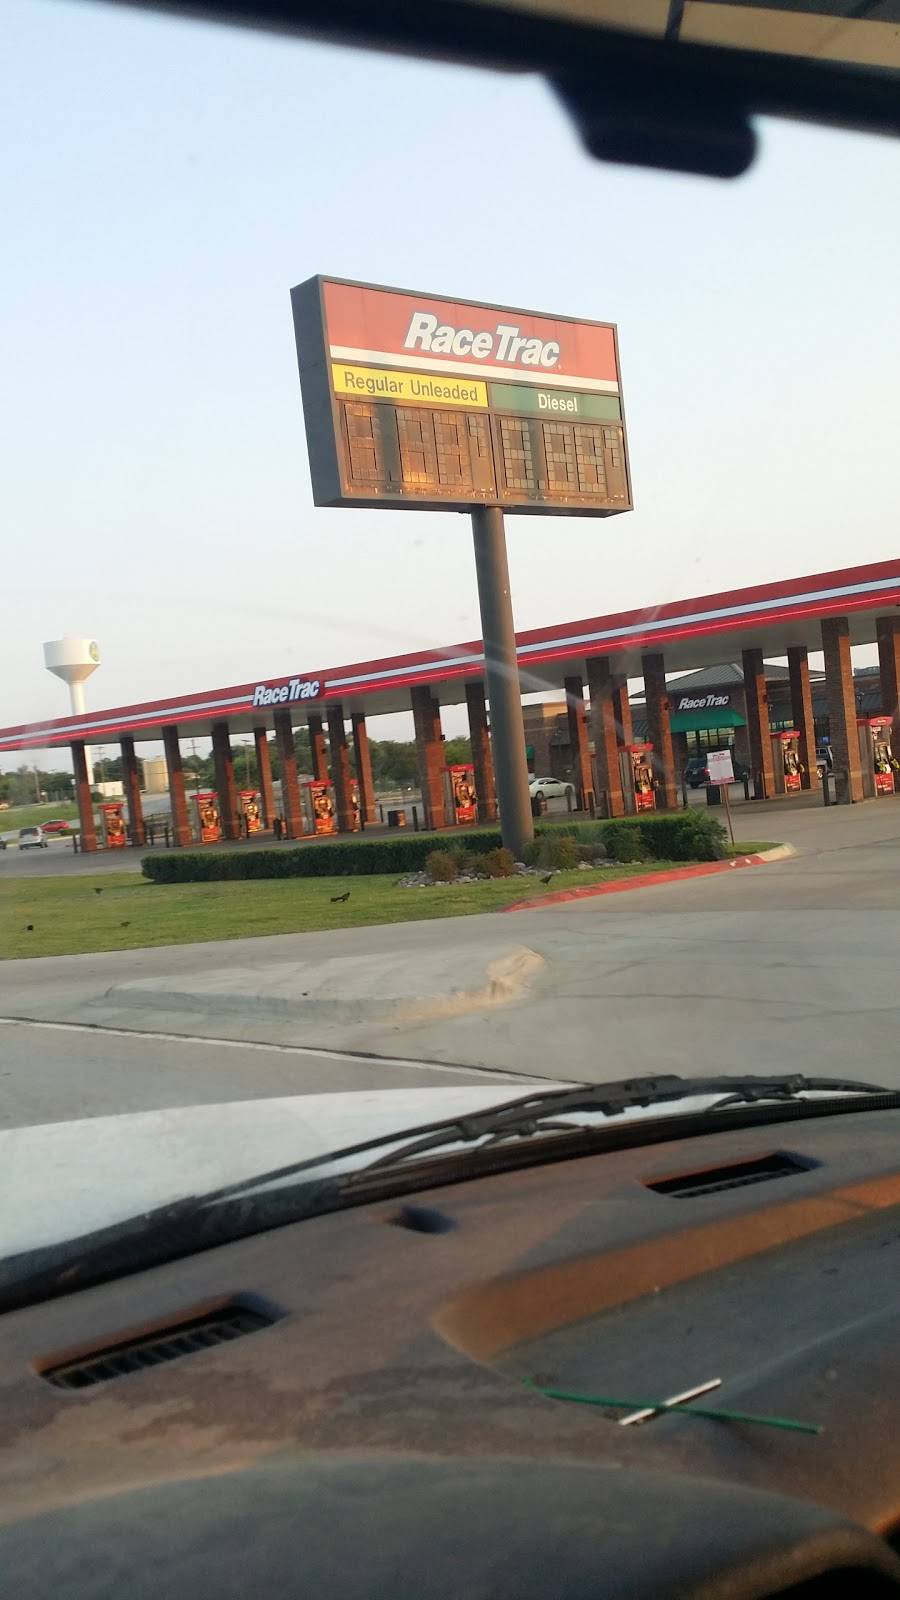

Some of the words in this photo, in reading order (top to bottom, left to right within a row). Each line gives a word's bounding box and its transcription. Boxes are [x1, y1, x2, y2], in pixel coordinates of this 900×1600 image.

[404, 311, 560, 367] RaceTrac
[344, 371, 403, 393] Regular
[410, 379, 478, 401] Unleaded
[537, 393, 578, 412] Diesel
[252, 678, 320, 706] RaceTrac
[678, 694, 729, 710] RaceTrac
